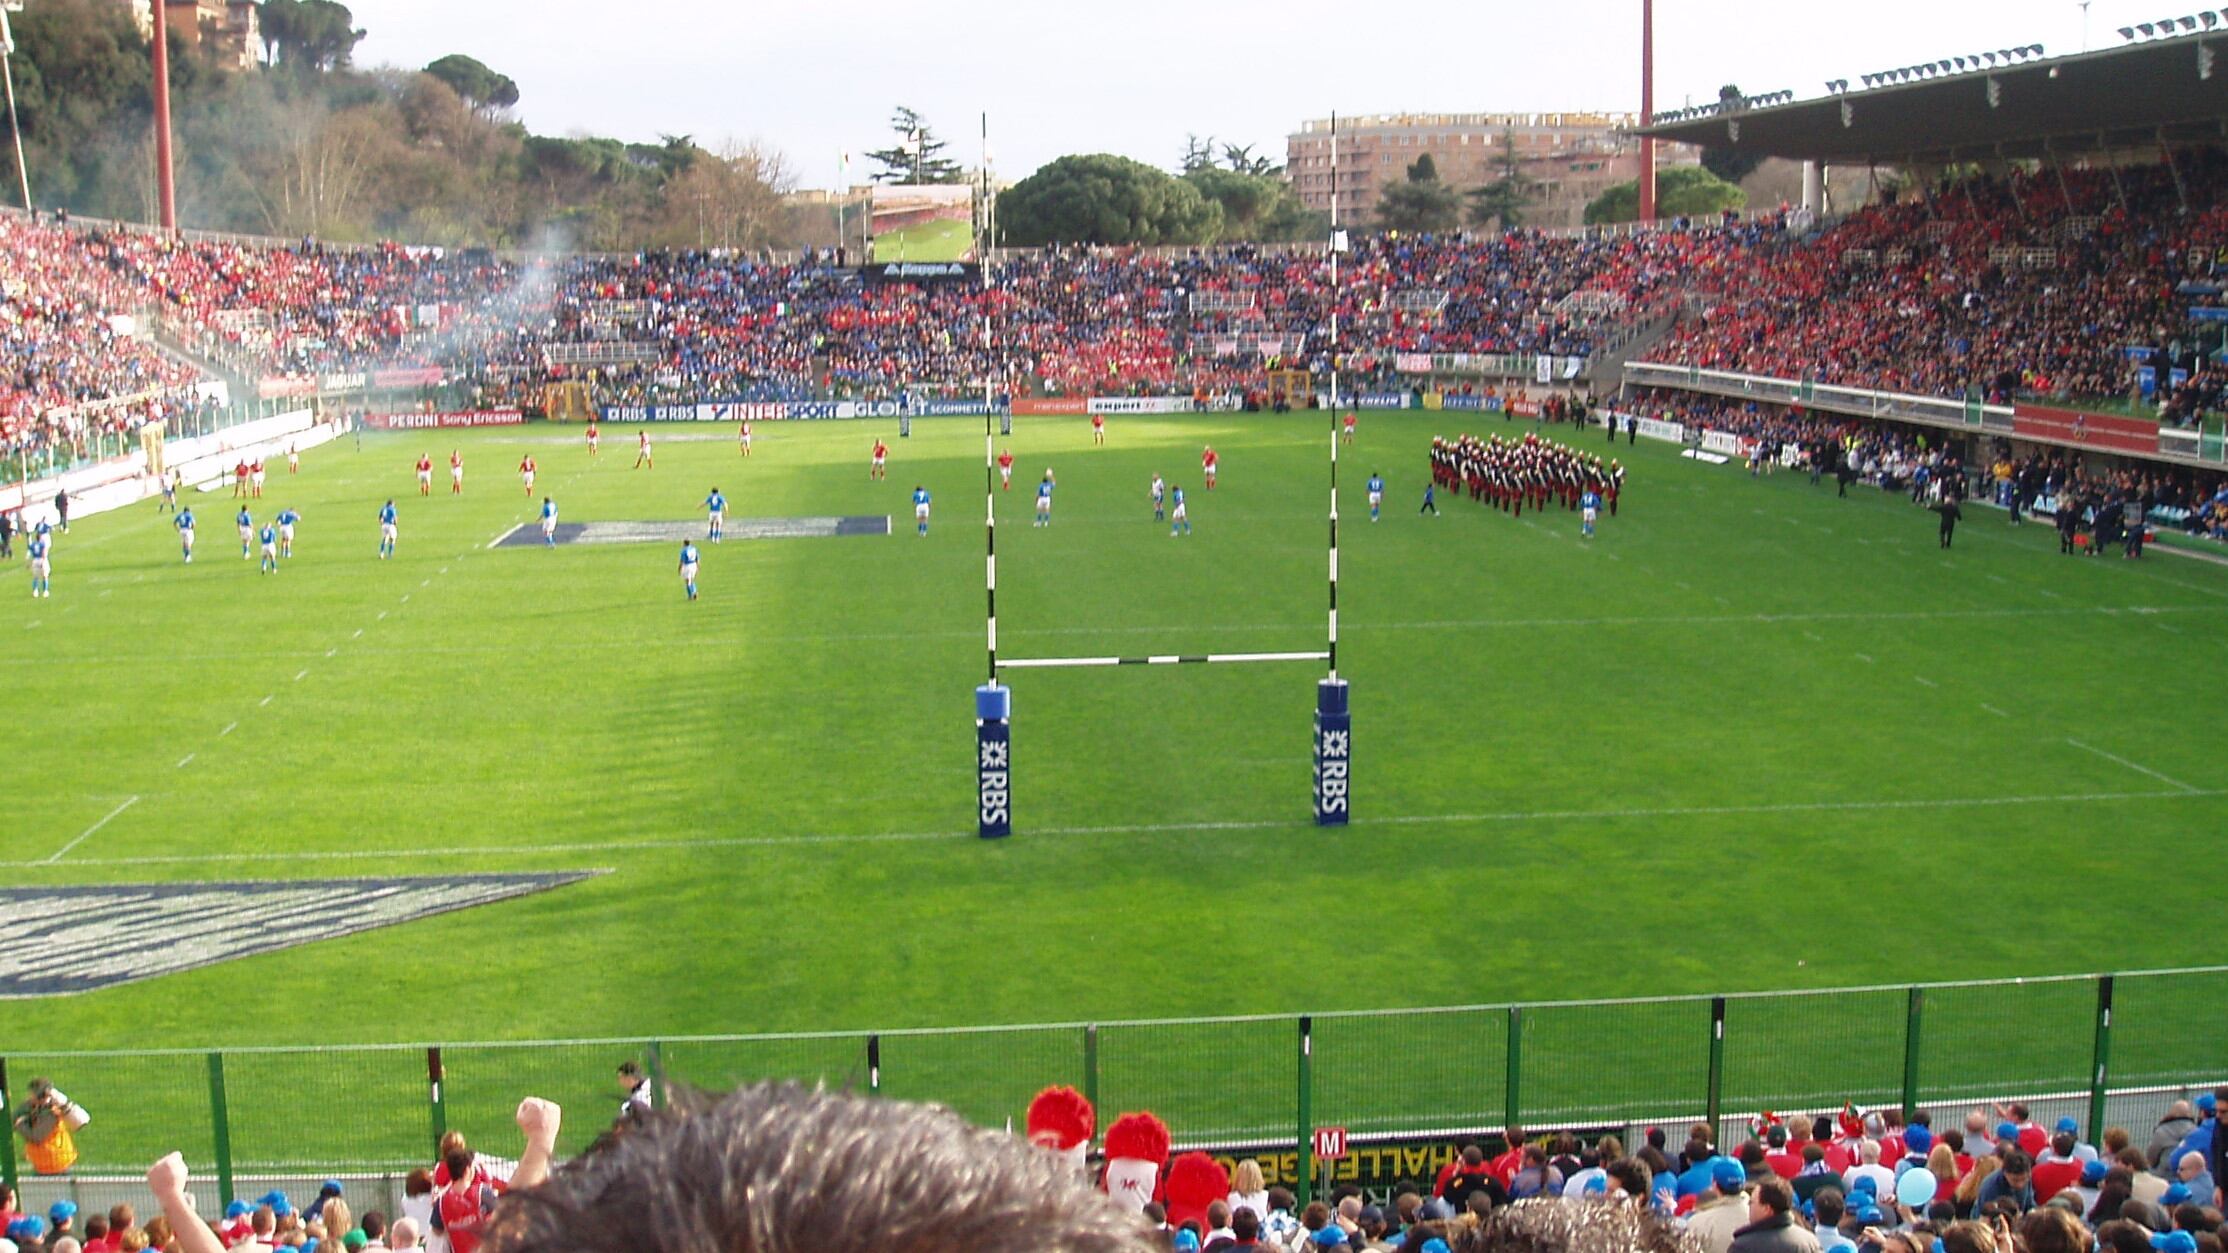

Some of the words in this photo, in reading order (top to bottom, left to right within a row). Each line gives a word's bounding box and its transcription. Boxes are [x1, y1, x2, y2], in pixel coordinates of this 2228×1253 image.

[326, 373, 366, 390] JAGUAR
[442, 412, 472, 427] Sony
[473, 409, 523, 425] Ericsson
[621, 405, 647, 420] RBS
[669, 404, 695, 420] RBS
[732, 402, 839, 420] INTERSPORT
[389, 413, 439, 428] PERONI
[1322, 760, 1347, 814] RBS
[981, 771, 1007, 825] RBS
[1320, 1131, 1340, 1156] M
[1256, 1144, 1456, 1184] HALLENGE
